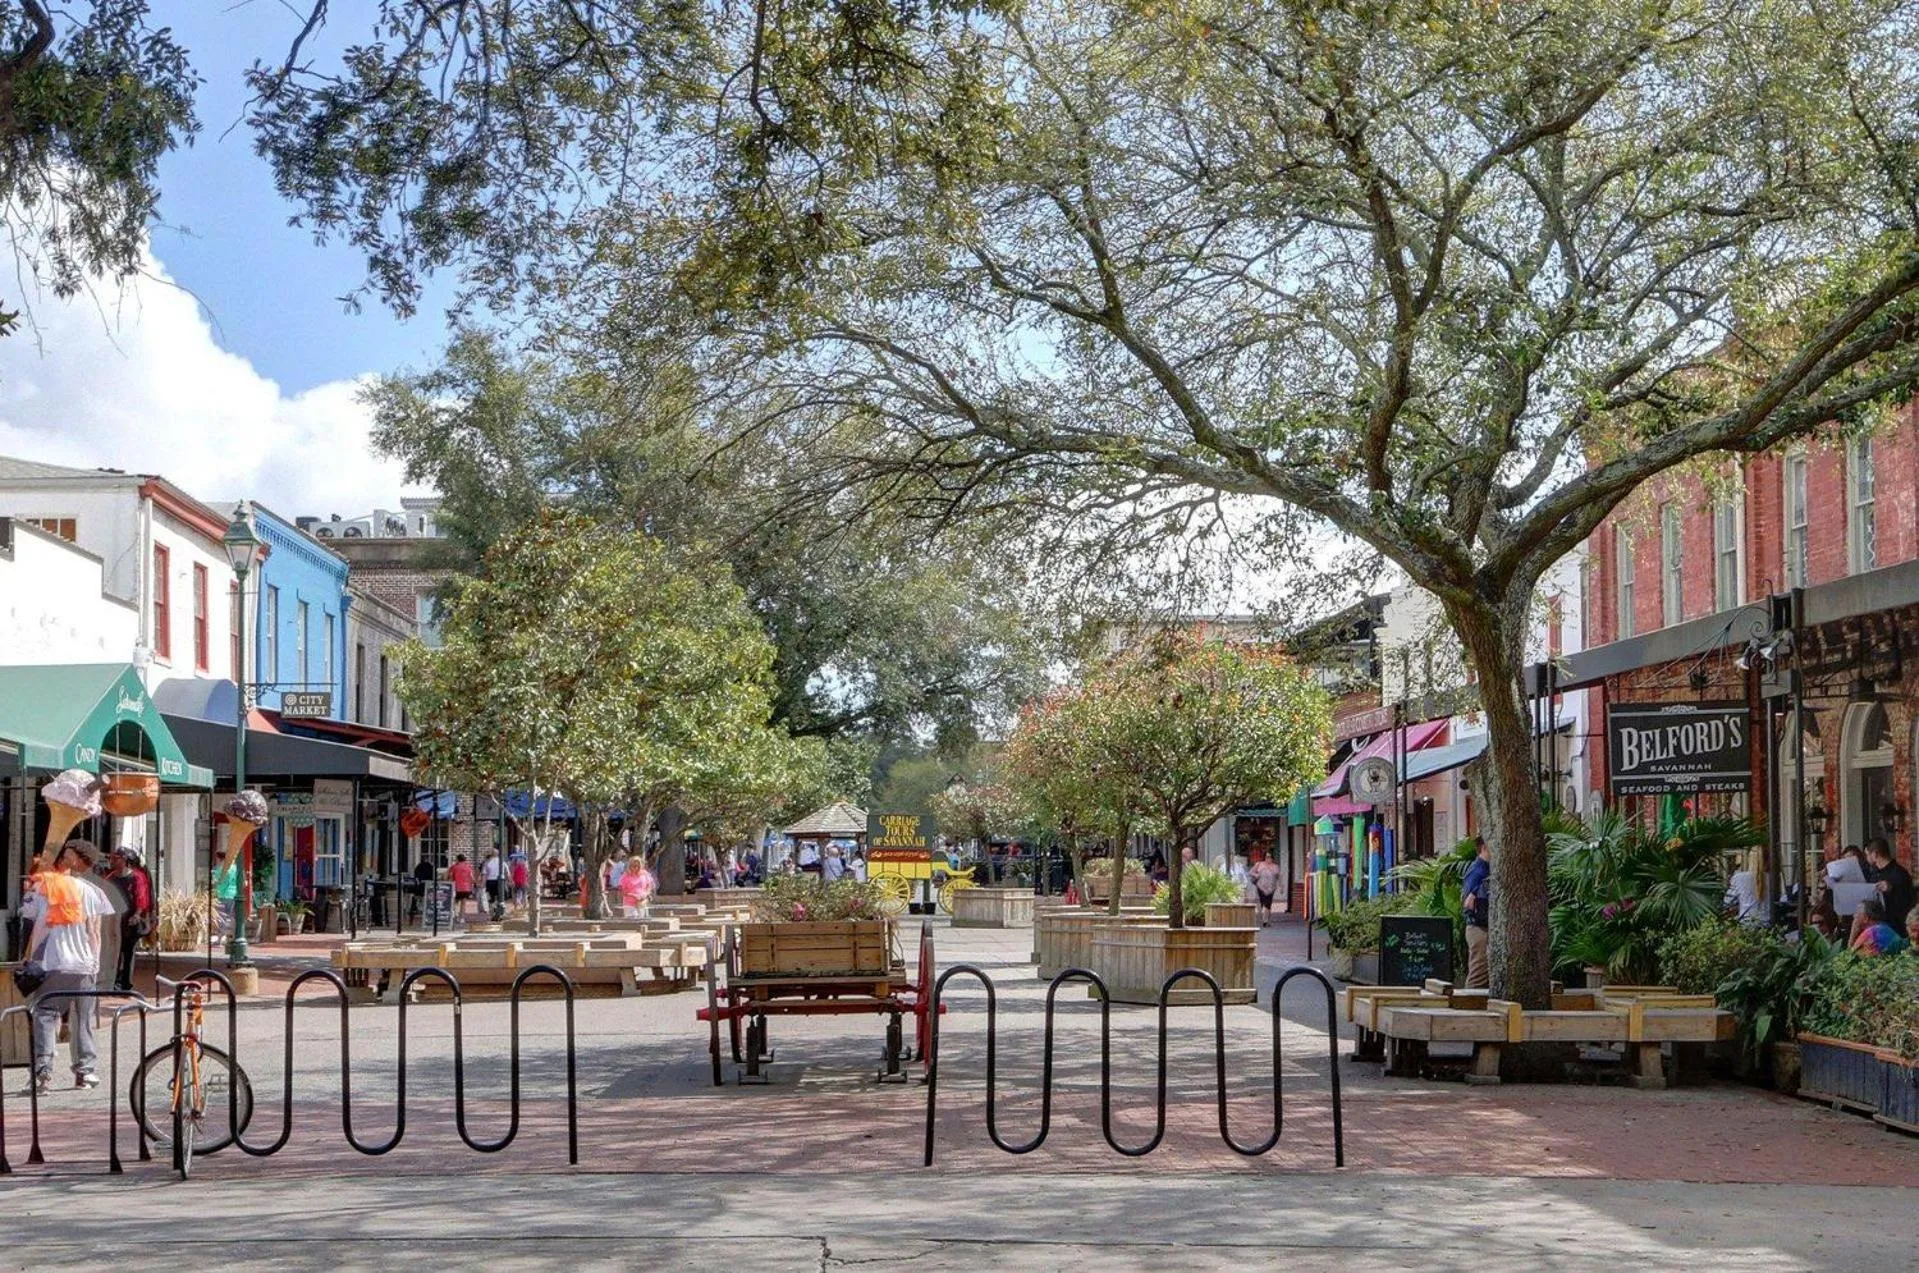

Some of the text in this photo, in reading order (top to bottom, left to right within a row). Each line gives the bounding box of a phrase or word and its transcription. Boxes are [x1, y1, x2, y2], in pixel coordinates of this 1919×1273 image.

[299, 695, 324, 705] CITY
[284, 705, 327, 715] MARKET
[1619, 714, 1743, 771] BELFORD'S
[1650, 763, 1712, 772] SAVANNAH
[1620, 782, 1745, 794] SEAFOOD AND STEAKS
[879, 815, 921, 826] CARRIAGE
[885, 825, 915, 837] TOURS
[883, 836, 926, 847] SAVANNAH
